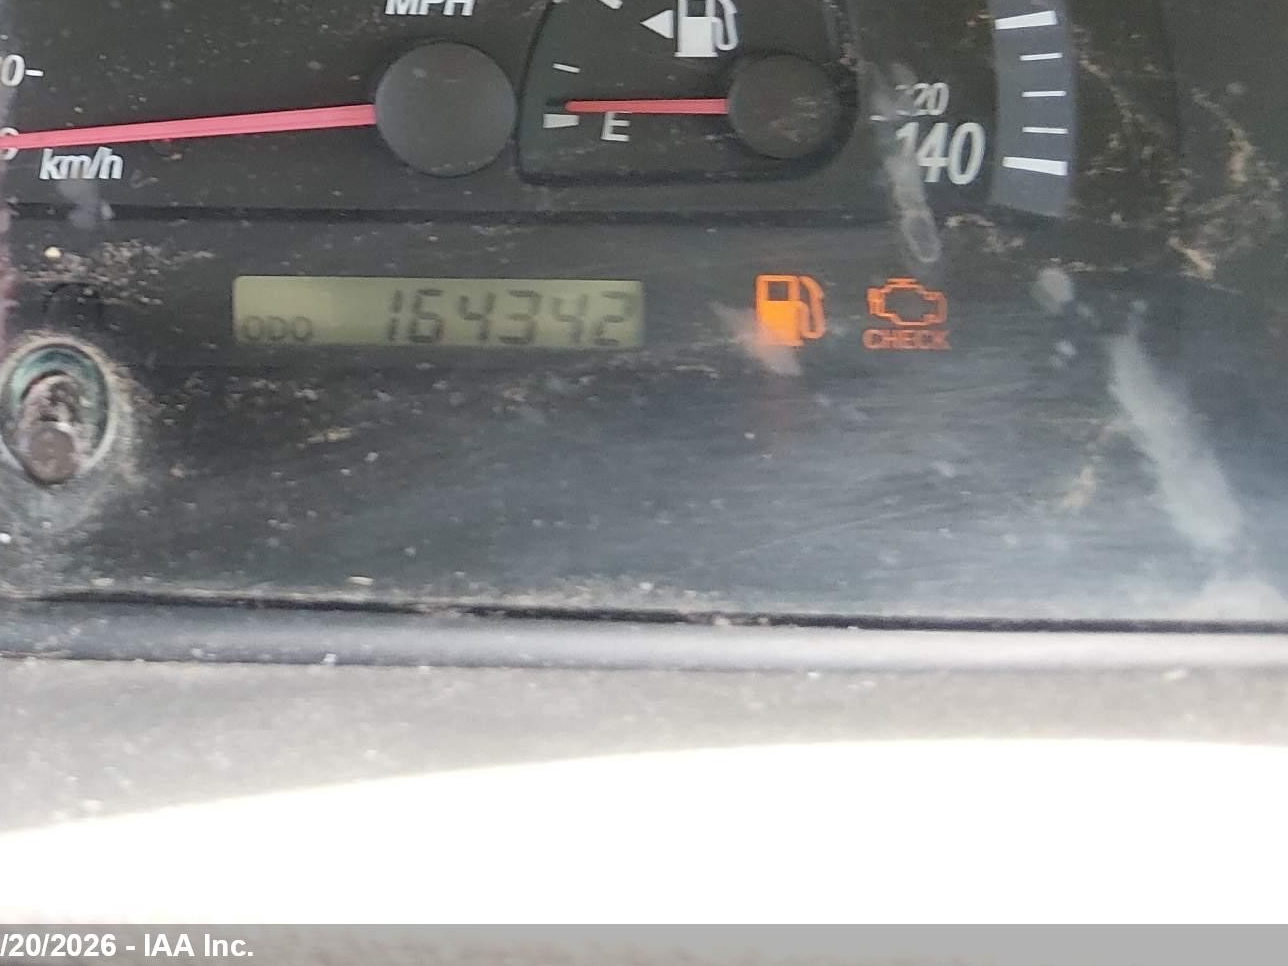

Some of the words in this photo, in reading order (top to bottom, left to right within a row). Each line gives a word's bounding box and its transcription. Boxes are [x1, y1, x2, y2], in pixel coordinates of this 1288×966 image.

[602, 111, 629, 142] E
[39, 147, 123, 179] km/h
[894, 122, 986, 185] 140
[242, 316, 311, 342] ODO
[388, 289, 636, 344] 164342
